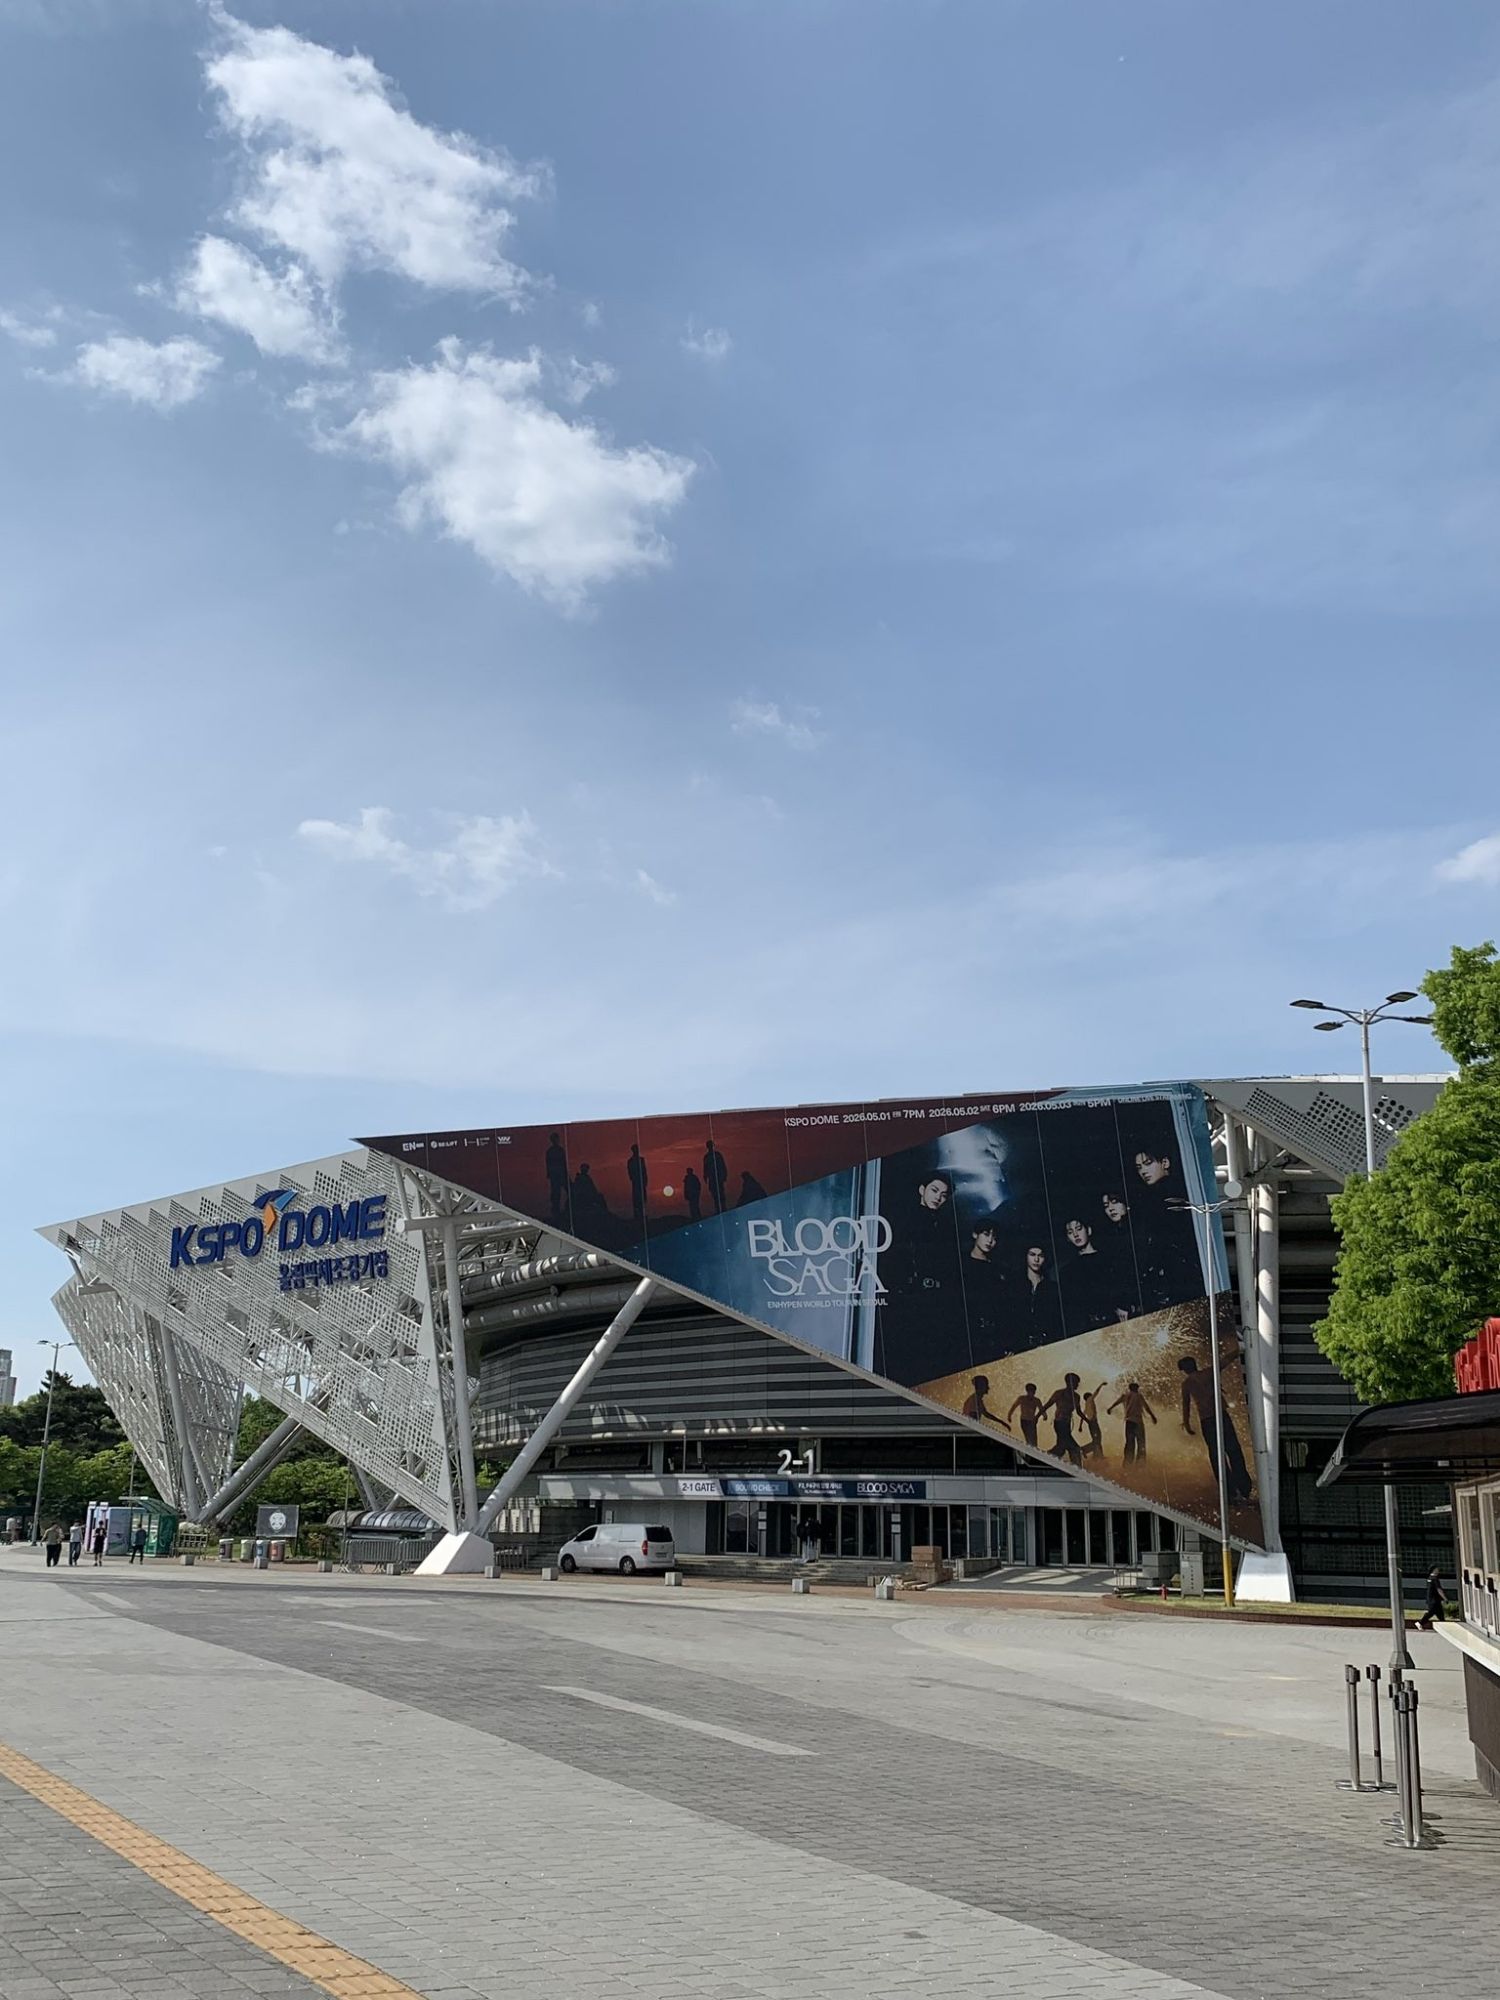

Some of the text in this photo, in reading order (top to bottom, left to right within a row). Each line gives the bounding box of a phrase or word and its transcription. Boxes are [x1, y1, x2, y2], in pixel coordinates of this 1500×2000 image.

[784, 1117, 809, 1127] KSPO
[810, 1114, 840, 1125] DOME
[843, 1111, 891, 1123] 2026.05.01
[903, 1108, 925, 1119] 7PM
[928, 1105, 980, 1118] 2026.05.02
[992, 1103, 1016, 1114] 6PM
[1019, 1100, 1072, 1112] 2026.05.03
[1087, 1097, 1111, 1108] 5PM
[170, 1195, 387, 1268] KSPO DOME
[748, 1215, 893, 1258] BLOOD
[763, 1254, 889, 1296] SAGA
[767, 1300, 804, 1309] ENHYPEN
[804, 1299, 832, 1308] WORLD
[777, 1449, 814, 1475] 2-1
[682, 1482, 716, 1492] 2-1 GATE
[857, 1482, 915, 1494] BLOOD SAGA
